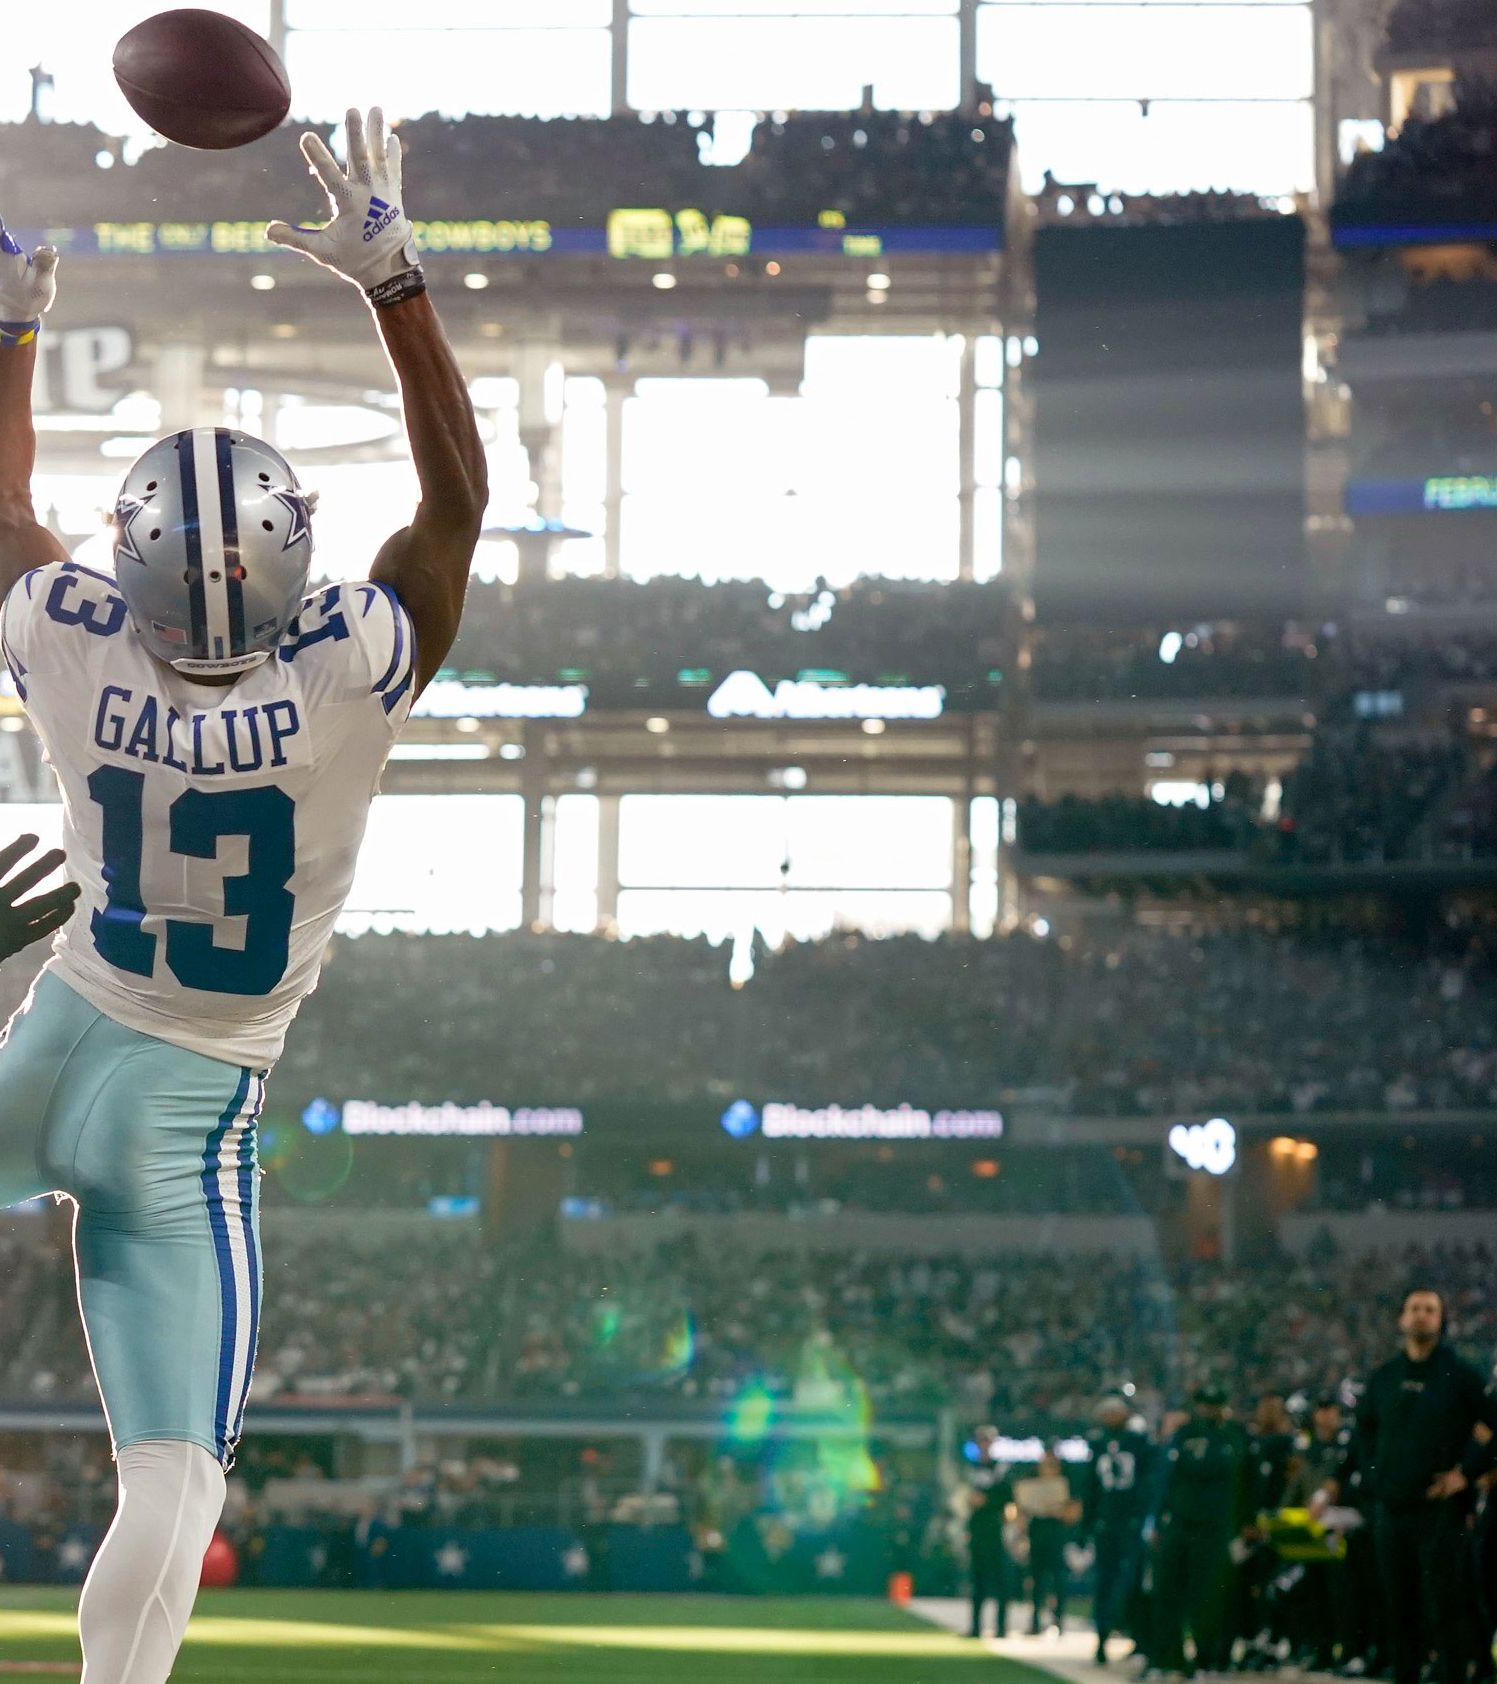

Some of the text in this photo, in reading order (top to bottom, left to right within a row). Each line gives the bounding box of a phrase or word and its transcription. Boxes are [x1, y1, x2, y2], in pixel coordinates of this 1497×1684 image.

[94, 222, 155, 253] THE
[210, 221, 288, 253] BEE
[362, 206, 400, 243] adidas
[93, 684, 302, 776] GALLUP
[86, 763, 297, 997] 13
